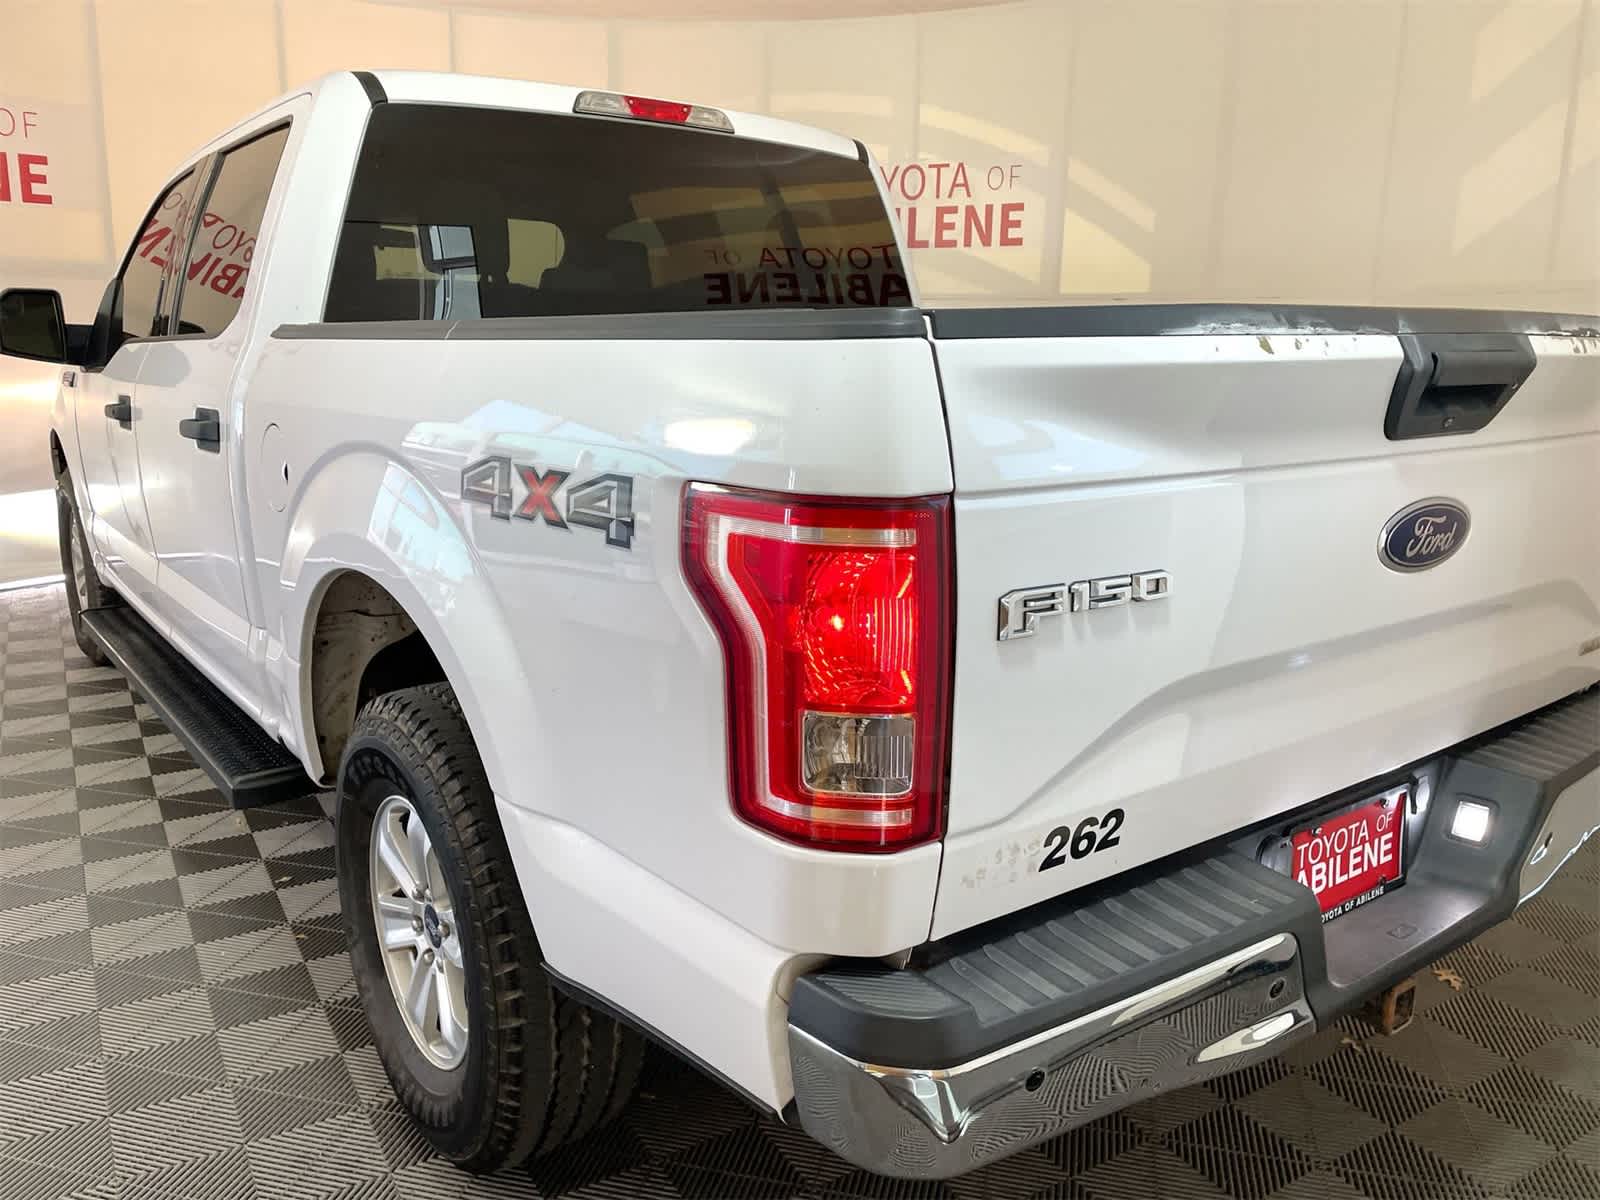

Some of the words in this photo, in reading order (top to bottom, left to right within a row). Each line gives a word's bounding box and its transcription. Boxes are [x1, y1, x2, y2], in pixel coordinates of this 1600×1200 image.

[987, 164, 1023, 191] OF
[1405, 515, 1457, 558] Ford
[1038, 808, 1125, 872] 262
[1297, 819, 1369, 869] TOYOTA
[1376, 811, 1393, 832] OF
[1297, 832, 1394, 895] ABILENE
[1344, 900, 1355, 912] OF
[1356, 885, 1385, 907] ABILENE
